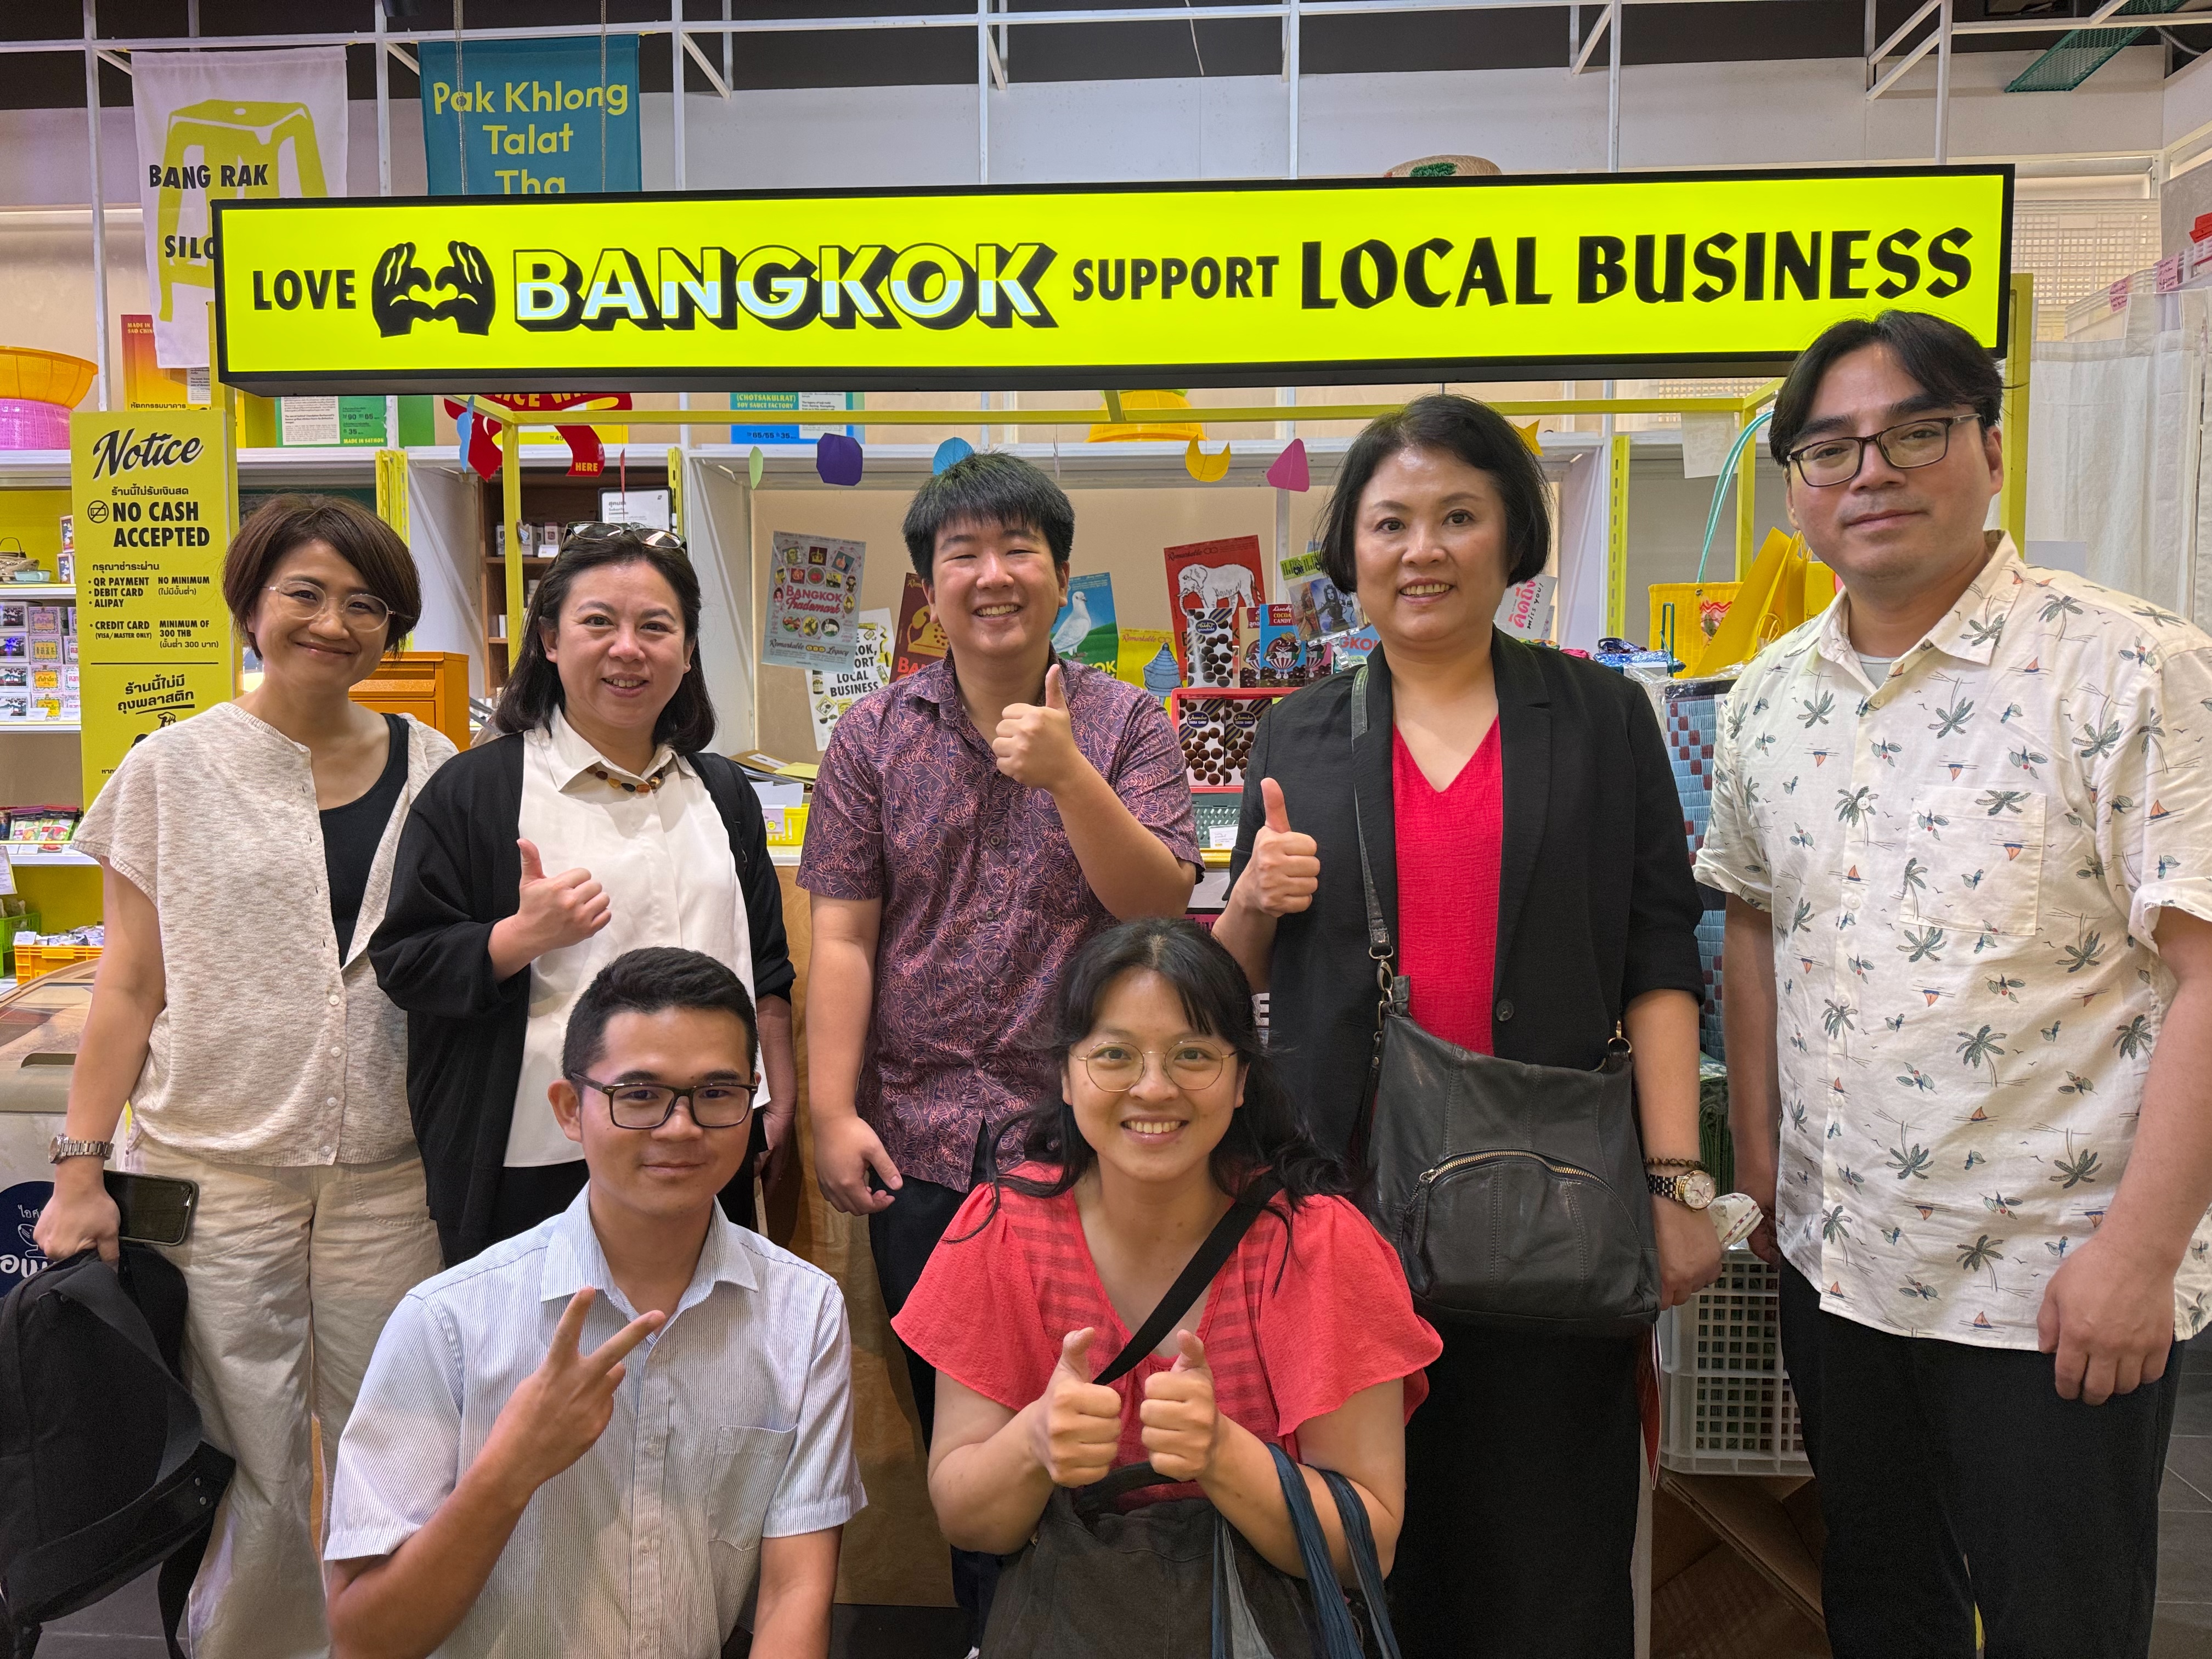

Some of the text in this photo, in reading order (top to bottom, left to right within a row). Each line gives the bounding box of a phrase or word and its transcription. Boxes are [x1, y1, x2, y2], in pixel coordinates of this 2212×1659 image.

[433, 81, 628, 115] Pak Khlong
[483, 123, 573, 155] Talat
[149, 163, 269, 190] BANG RAK
[253, 226, 1973, 332] LOVE BANGKOK SUPPORT LOCAL BUSINESS
[93, 428, 204, 479] Notice
[575, 462, 598, 472] HERE
[111, 483, 189, 496] ร้านนี้ไม่รับเงินสด
[113, 501, 199, 522] NO CASH
[113, 527, 210, 548] ACCEPTED
[92, 561, 160, 573] กรุณาชำระผ่าน
[94, 577, 149, 586] QR PAYMENT
[94, 588, 144, 596] DEBIT CARD
[786, 585, 843, 603] BANGKOK
[94, 599, 124, 607] ALIPAY
[786, 597, 841, 614] Trademark
[95, 621, 150, 630] CREDIT CARD
[855, 644, 877, 656] OK,
[125, 673, 185, 695] ร้านนี้ไม่มี
[837, 670, 869, 684] LOCAL
[830, 681, 878, 697] BUSINESS
[117, 690, 194, 714] ถุงพลาสติก
